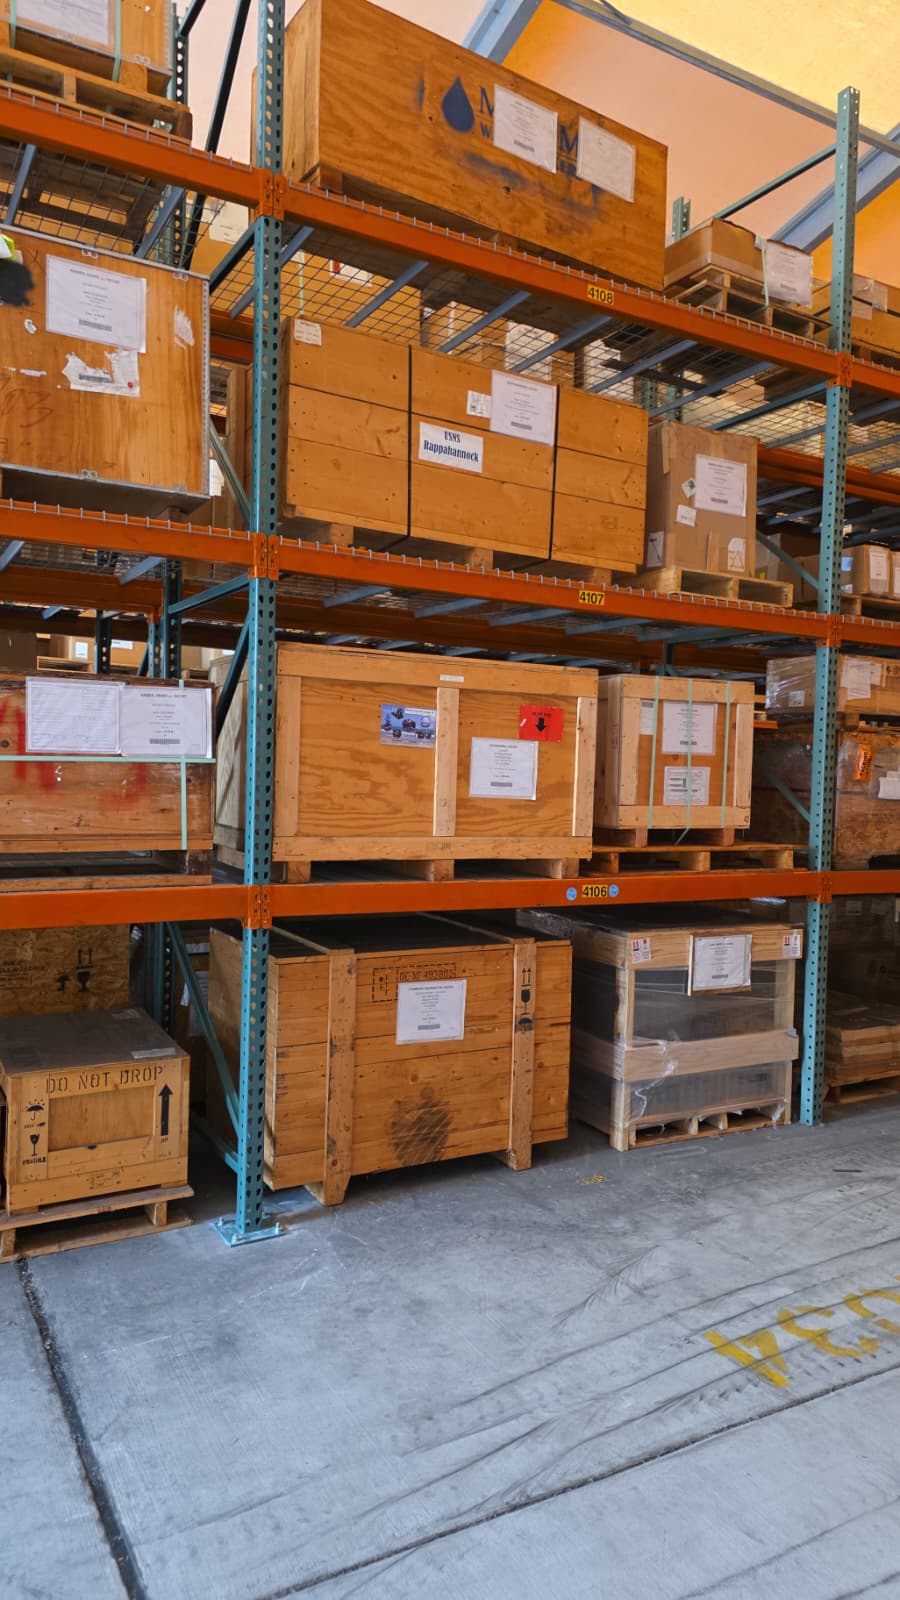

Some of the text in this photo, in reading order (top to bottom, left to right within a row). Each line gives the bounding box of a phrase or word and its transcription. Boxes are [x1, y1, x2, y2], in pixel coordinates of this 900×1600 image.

[588, 287, 613, 304] 4108
[444, 430, 461, 444] USNS
[423, 439, 479, 463] Rappahannock
[580, 591, 604, 605] 4107
[583, 886, 607, 897] 4106
[46, 1065, 164, 1094] DO NOT DROP
